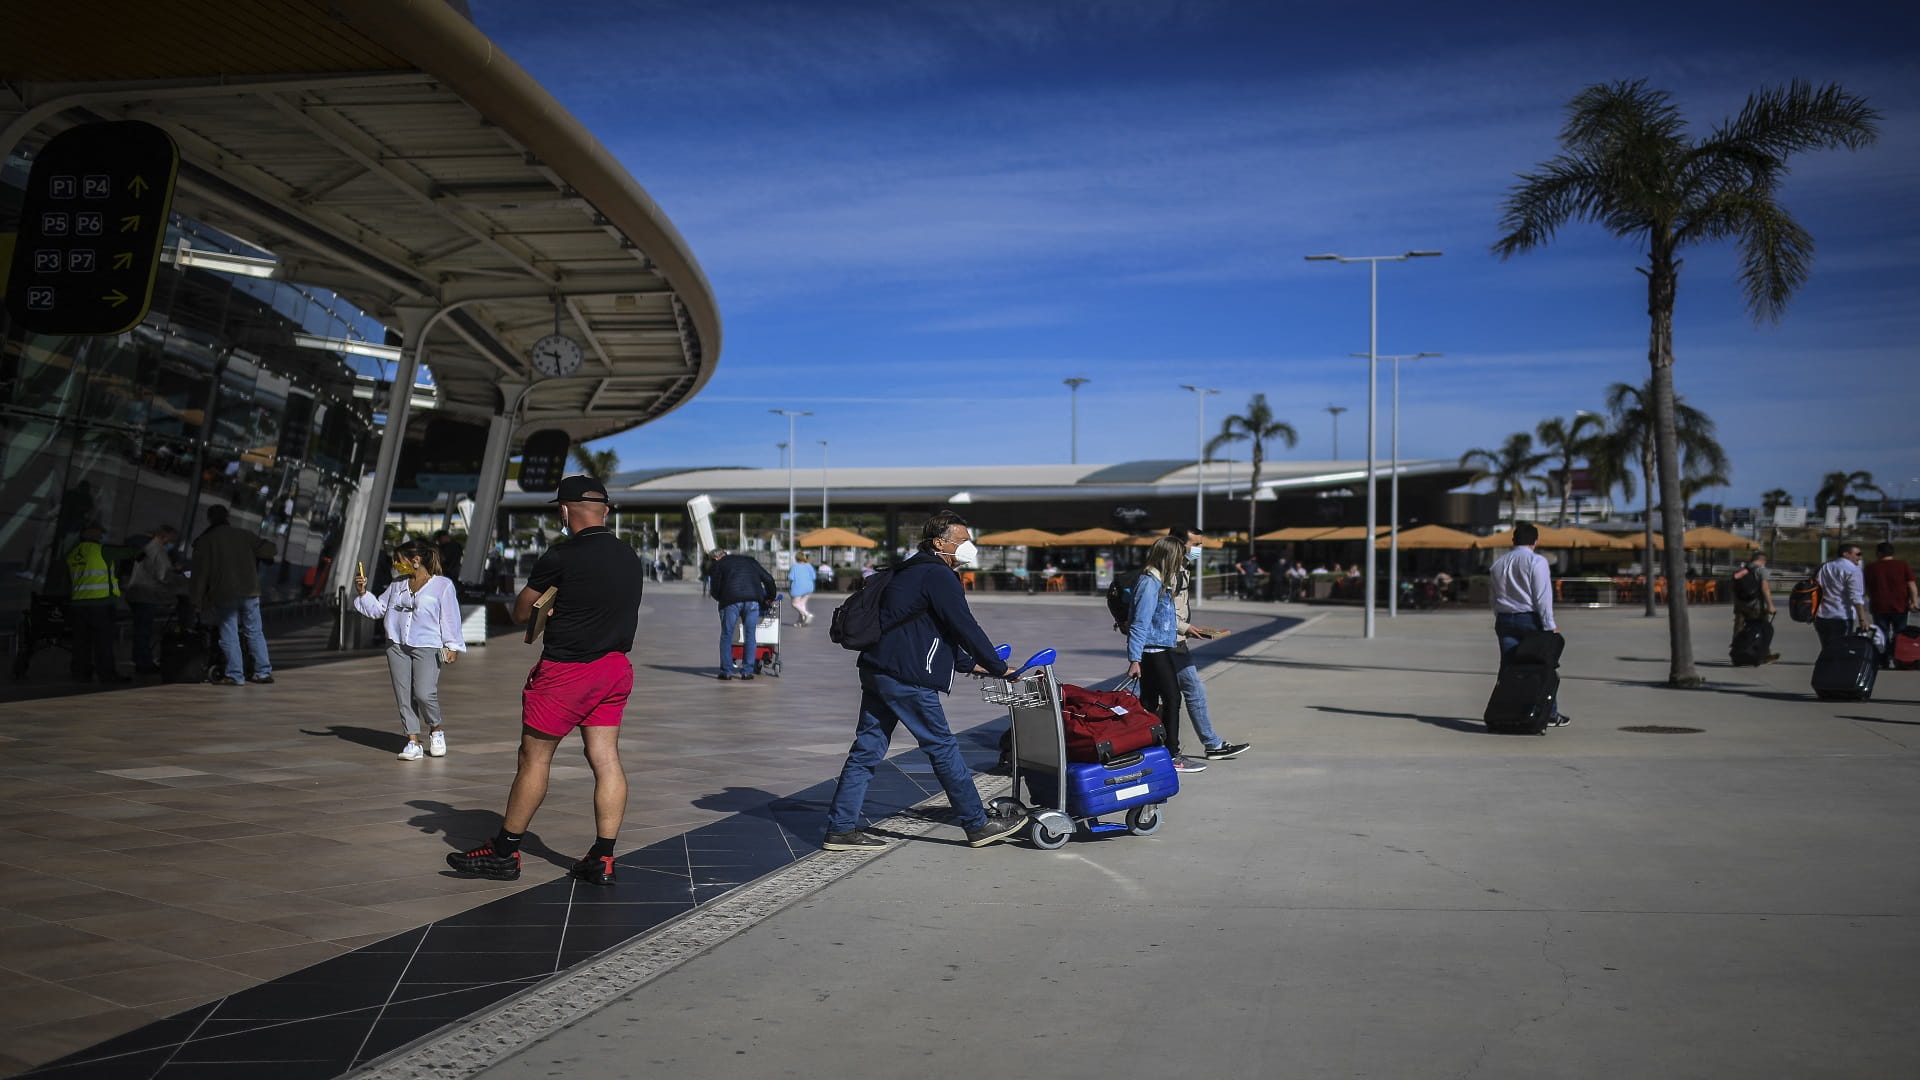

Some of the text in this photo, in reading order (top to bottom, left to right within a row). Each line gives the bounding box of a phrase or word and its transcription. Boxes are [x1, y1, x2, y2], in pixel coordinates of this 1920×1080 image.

[53, 179, 107, 195] P1 P4
[44, 216, 100, 232] P5 P6
[37, 254, 93, 268] P3 P7
[30, 291, 52, 305] P2
